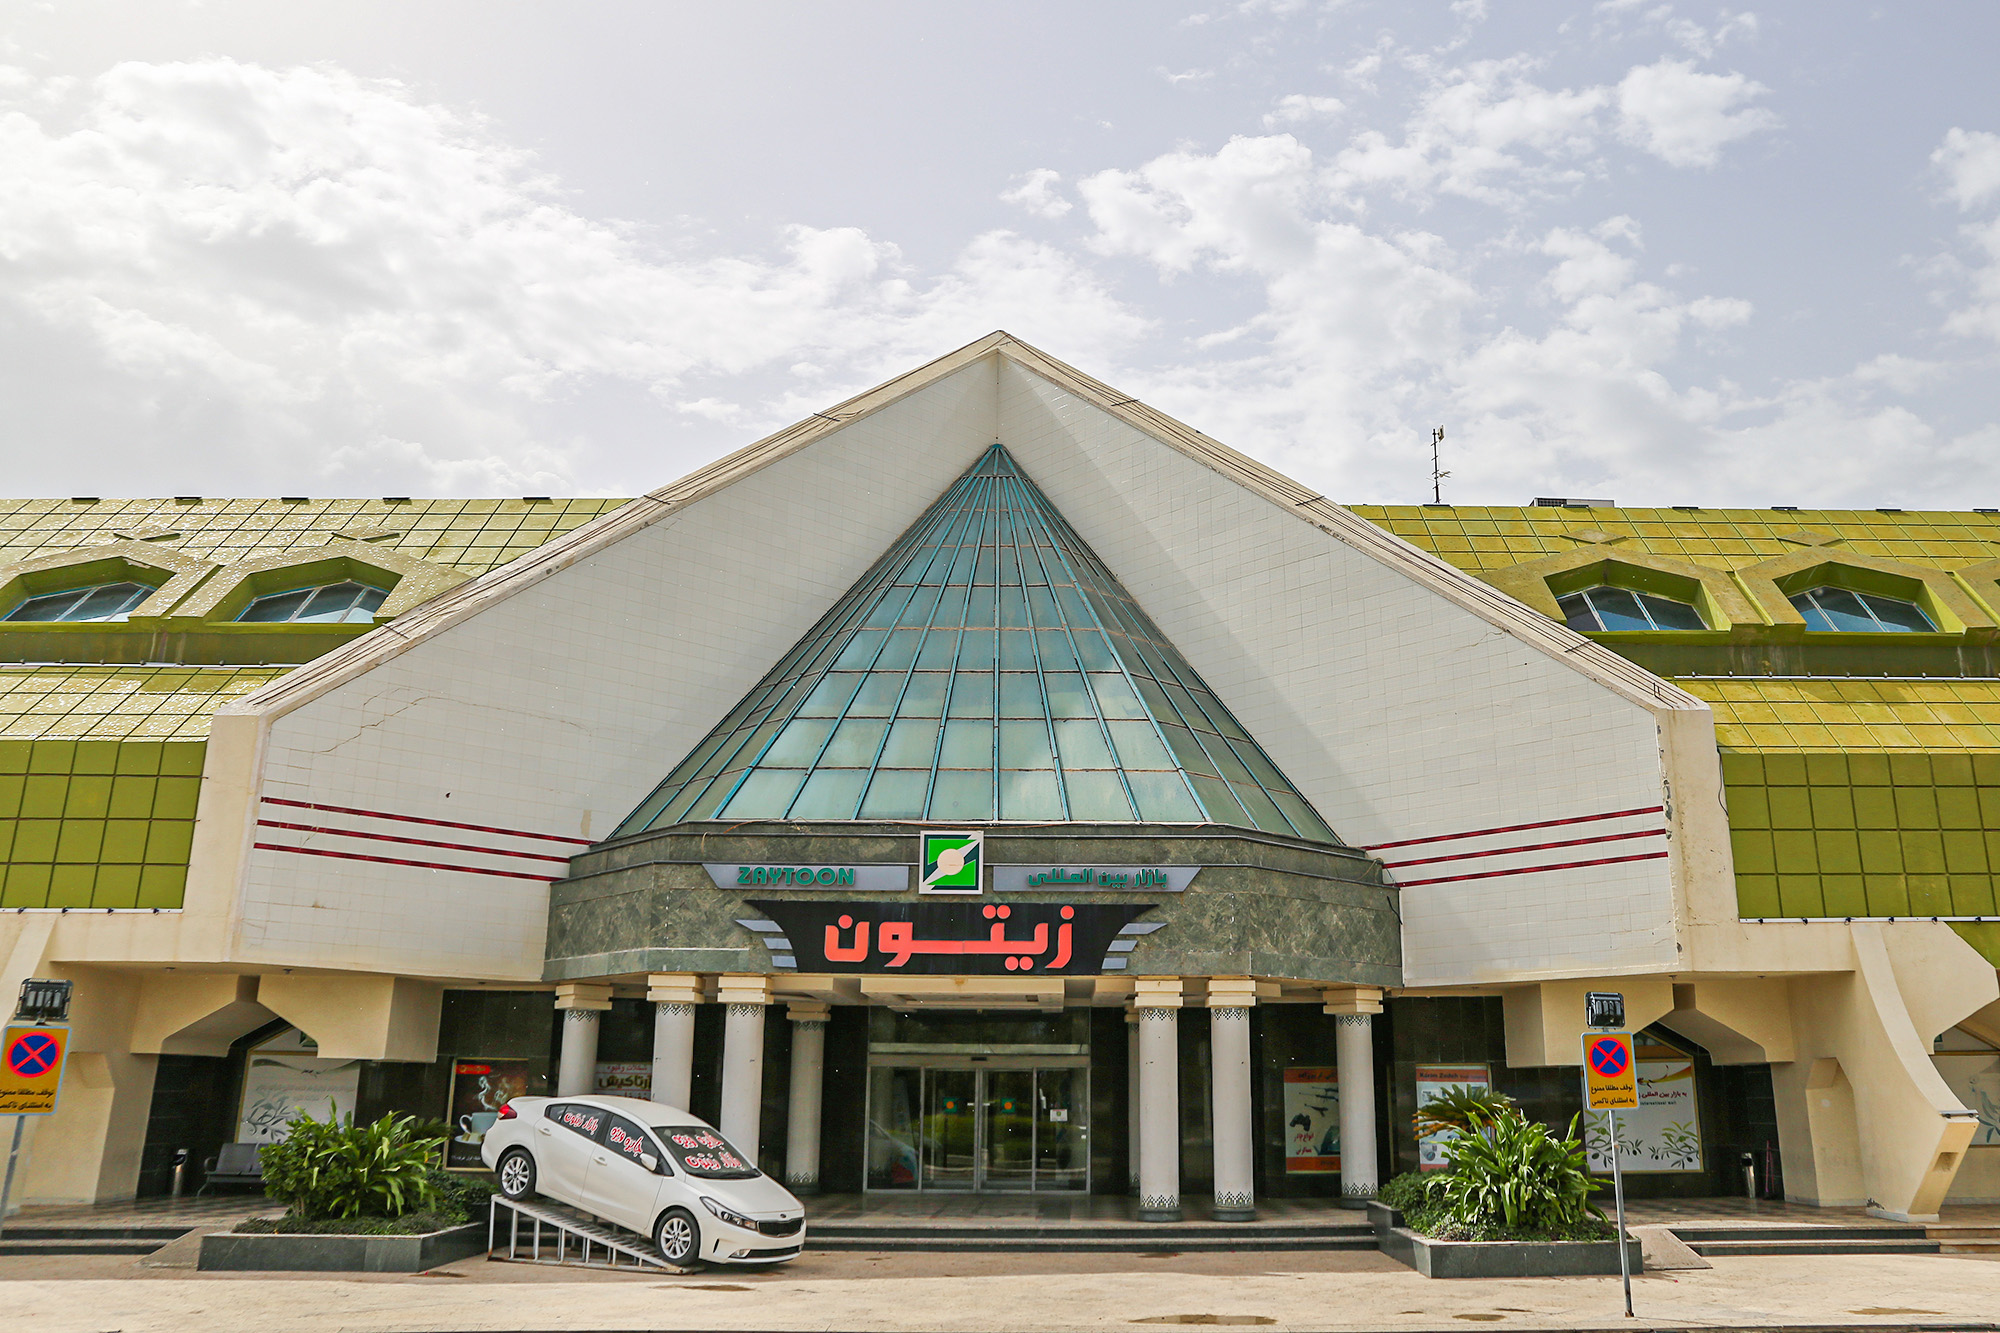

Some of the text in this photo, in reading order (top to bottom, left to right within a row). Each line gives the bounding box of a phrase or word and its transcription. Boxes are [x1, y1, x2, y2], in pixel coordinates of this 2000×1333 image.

[737, 867, 855, 886] ZAYTOON
[1098, 871, 1128, 888] بین
[1132, 868, 1168, 888] بازار
[824, 904, 1075, 972] زیتون
